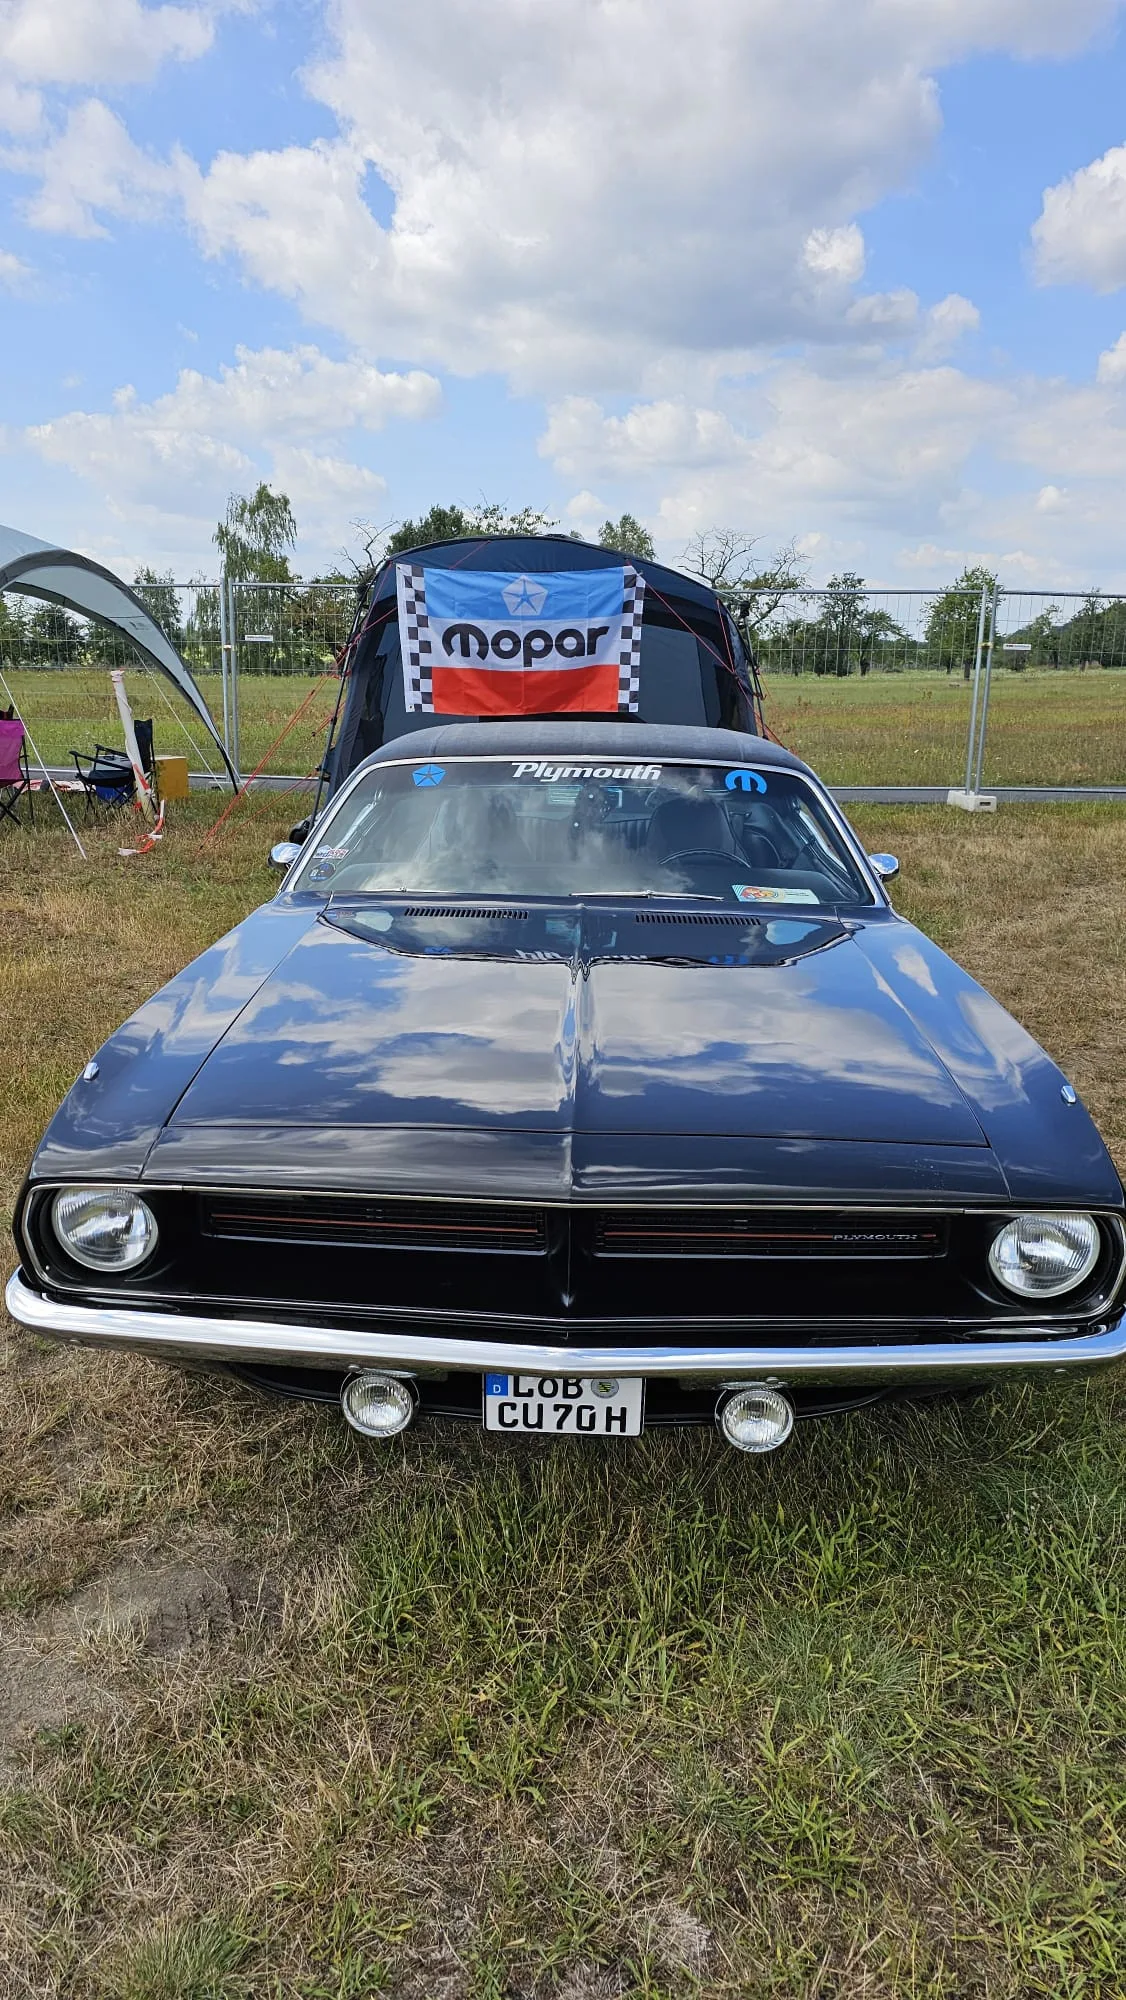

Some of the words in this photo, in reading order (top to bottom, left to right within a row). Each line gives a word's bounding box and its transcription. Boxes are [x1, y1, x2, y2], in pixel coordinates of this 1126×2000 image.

[511, 762, 663, 782] Plymouth
[493, 1384, 501, 1394] D
[513, 1375, 584, 1399] LOB
